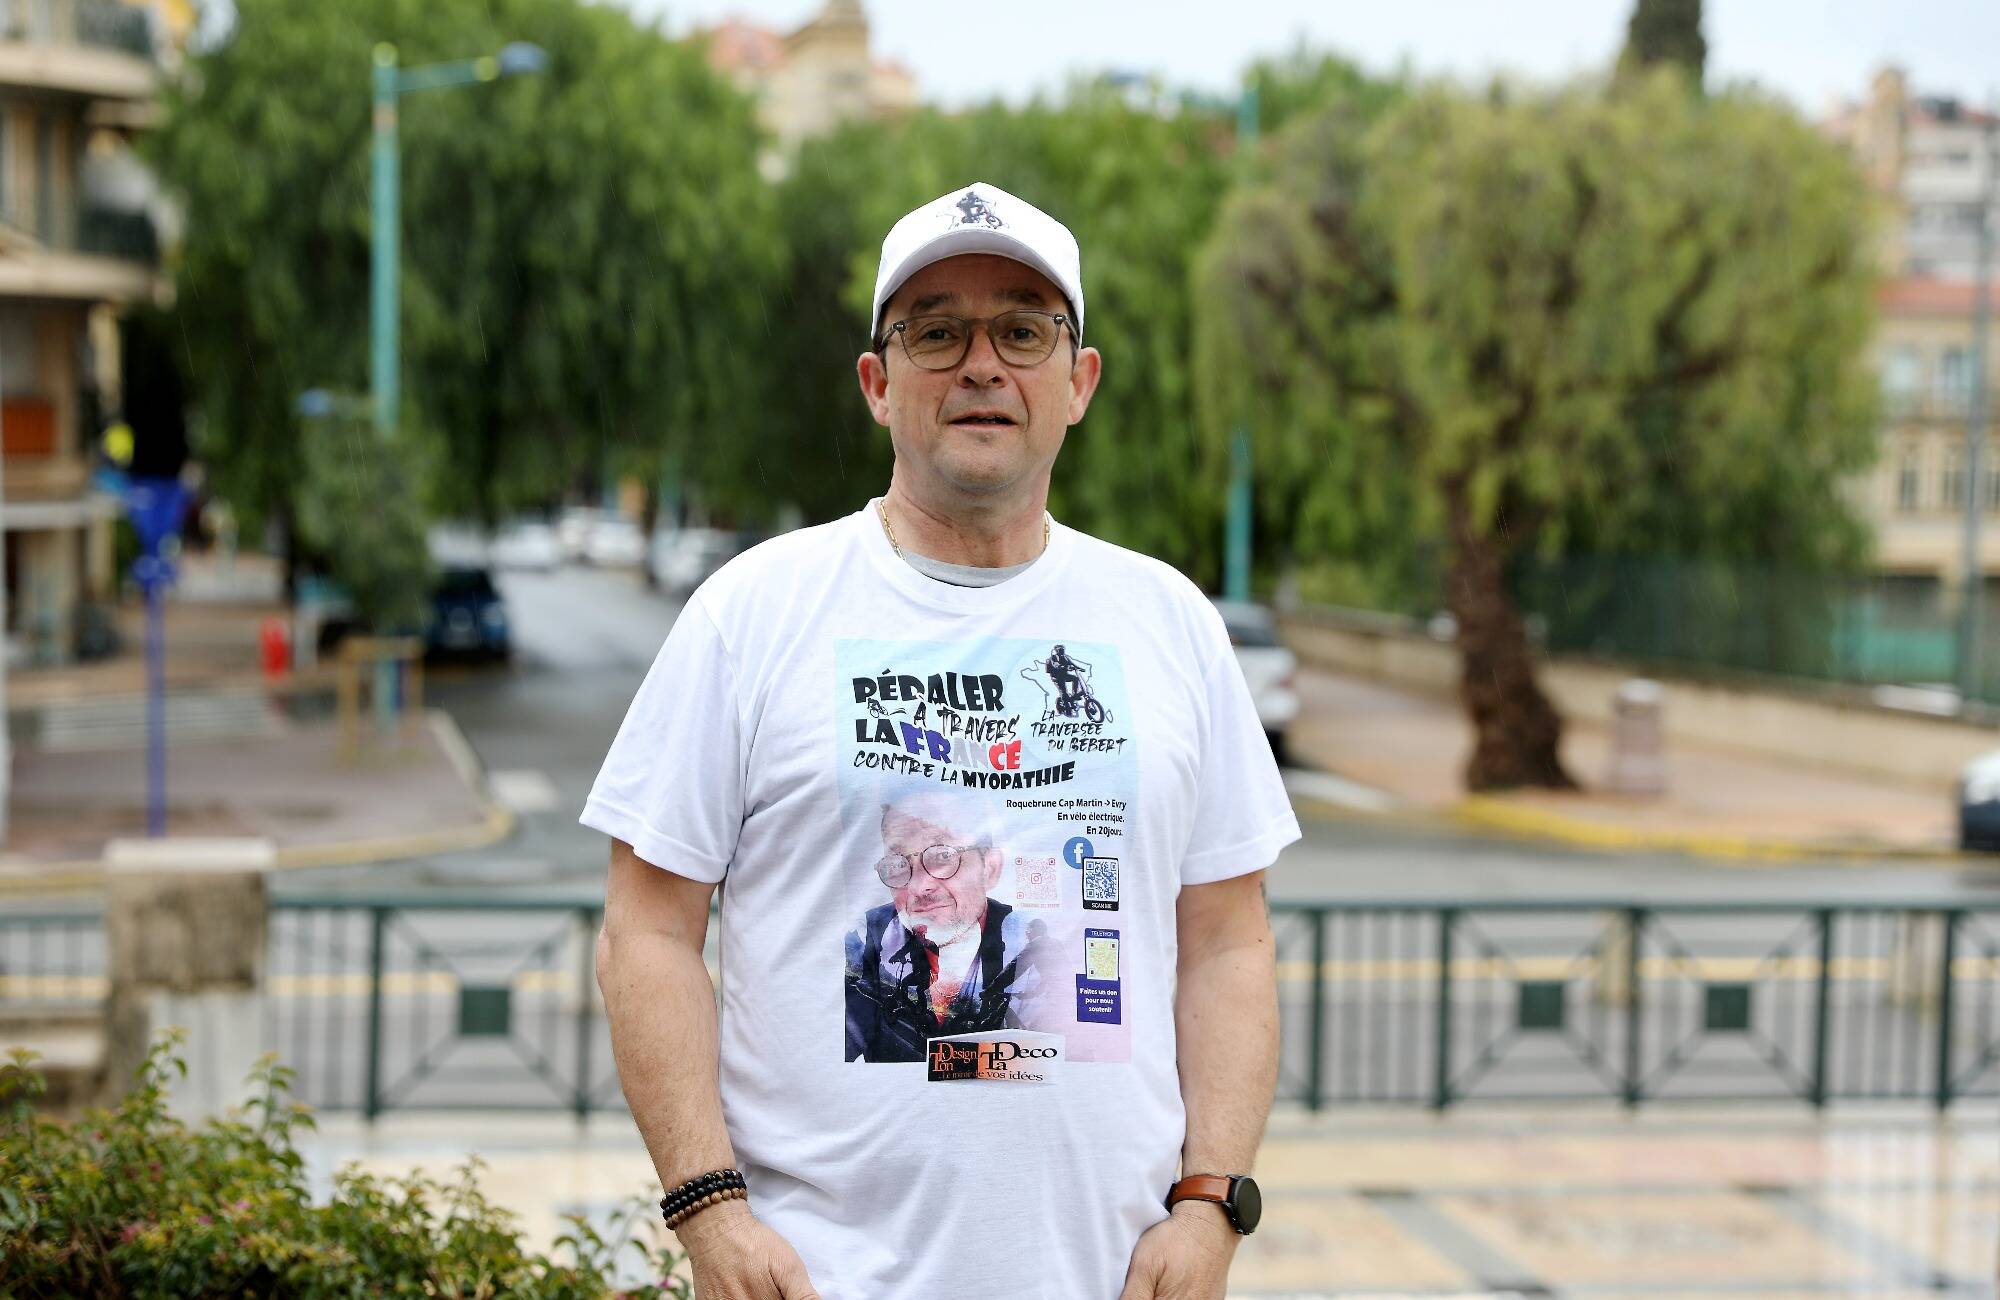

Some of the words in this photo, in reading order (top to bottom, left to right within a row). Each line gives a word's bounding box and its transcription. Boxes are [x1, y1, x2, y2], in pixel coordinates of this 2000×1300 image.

[853, 669, 1004, 712] PÉDALER
[937, 707, 1020, 742] TRAVERS
[1041, 710, 1055, 721] LA
[855, 719, 901, 746] LA
[900, 721, 1021, 771] FRANCE
[1048, 739, 1065, 751] DU
[854, 750, 934, 777] CONTRE
[941, 767, 957, 784] LA
[961, 761, 1075, 789] MYOPATHIE
[1006, 799, 1057, 809] Roquebrune
[1059, 799, 1074, 809] Cap
[1076, 799, 1102, 808] Martin
[1111, 800, 1126, 811] Evry
[1057, 812, 1068, 821] En
[1070, 812, 1087, 821] vélo
[1087, 826, 1097, 835] En
[937, 1042, 978, 1064] Design
[991, 1041, 1058, 1061] Deco
[981, 1052, 1008, 1071] Ta
[987, 1071, 1005, 1079] vos
[1009, 1071, 1044, 1081] idées
